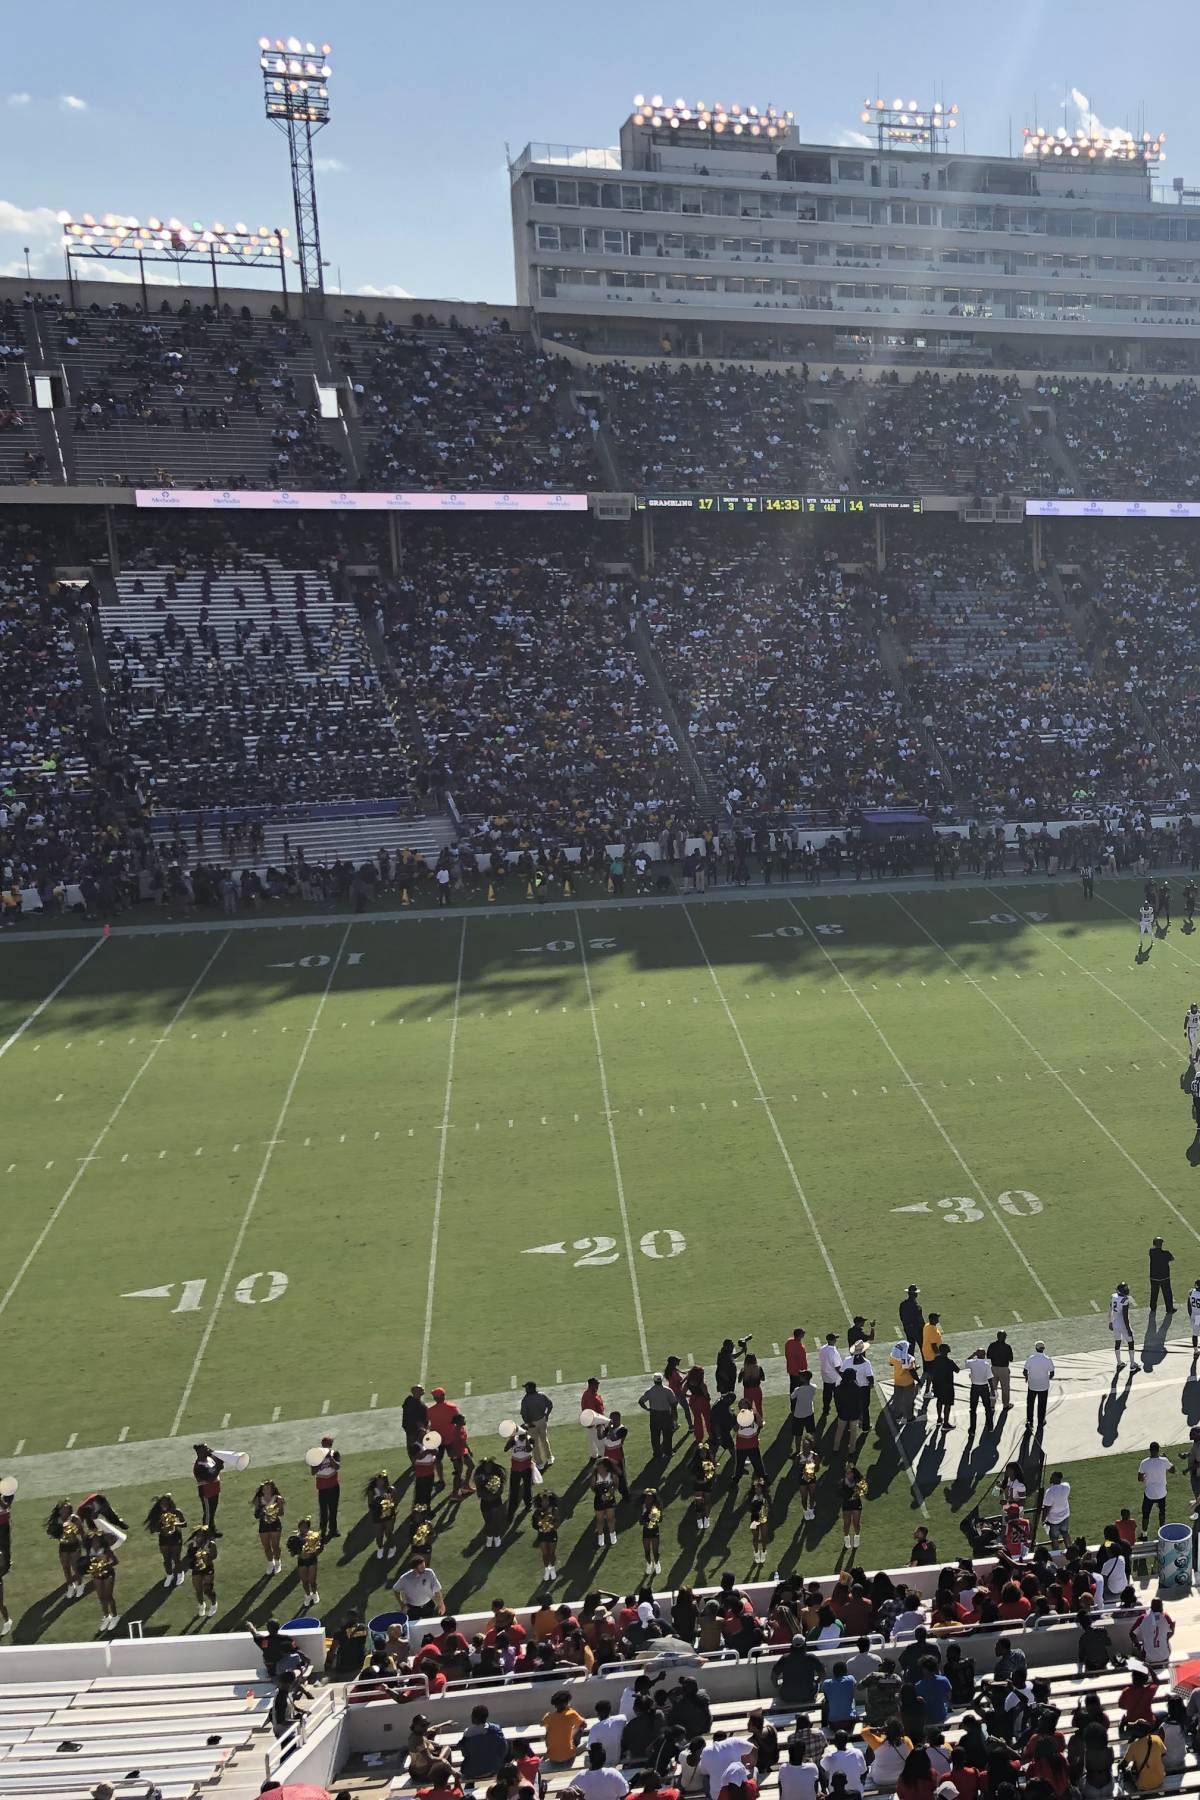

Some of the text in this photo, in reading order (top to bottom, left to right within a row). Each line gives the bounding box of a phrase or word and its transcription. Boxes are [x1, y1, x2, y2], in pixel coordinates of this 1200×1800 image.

[699, 498, 713, 510] 17
[728, 502, 735, 511] 3
[746, 502, 753, 511] 2
[766, 499, 800, 511] 14:33
[849, 500, 864, 511] 14
[776, 923, 845, 938] 30
[546, 937, 617, 951] 20
[299, 952, 366, 968] 10
[937, 1189, 1044, 1224] 30
[572, 1228, 687, 1268] 20
[170, 1270, 289, 1314] 10
[1112, 1301, 1118, 1313] 2
[1191, 1296, 1200, 1308] 26
